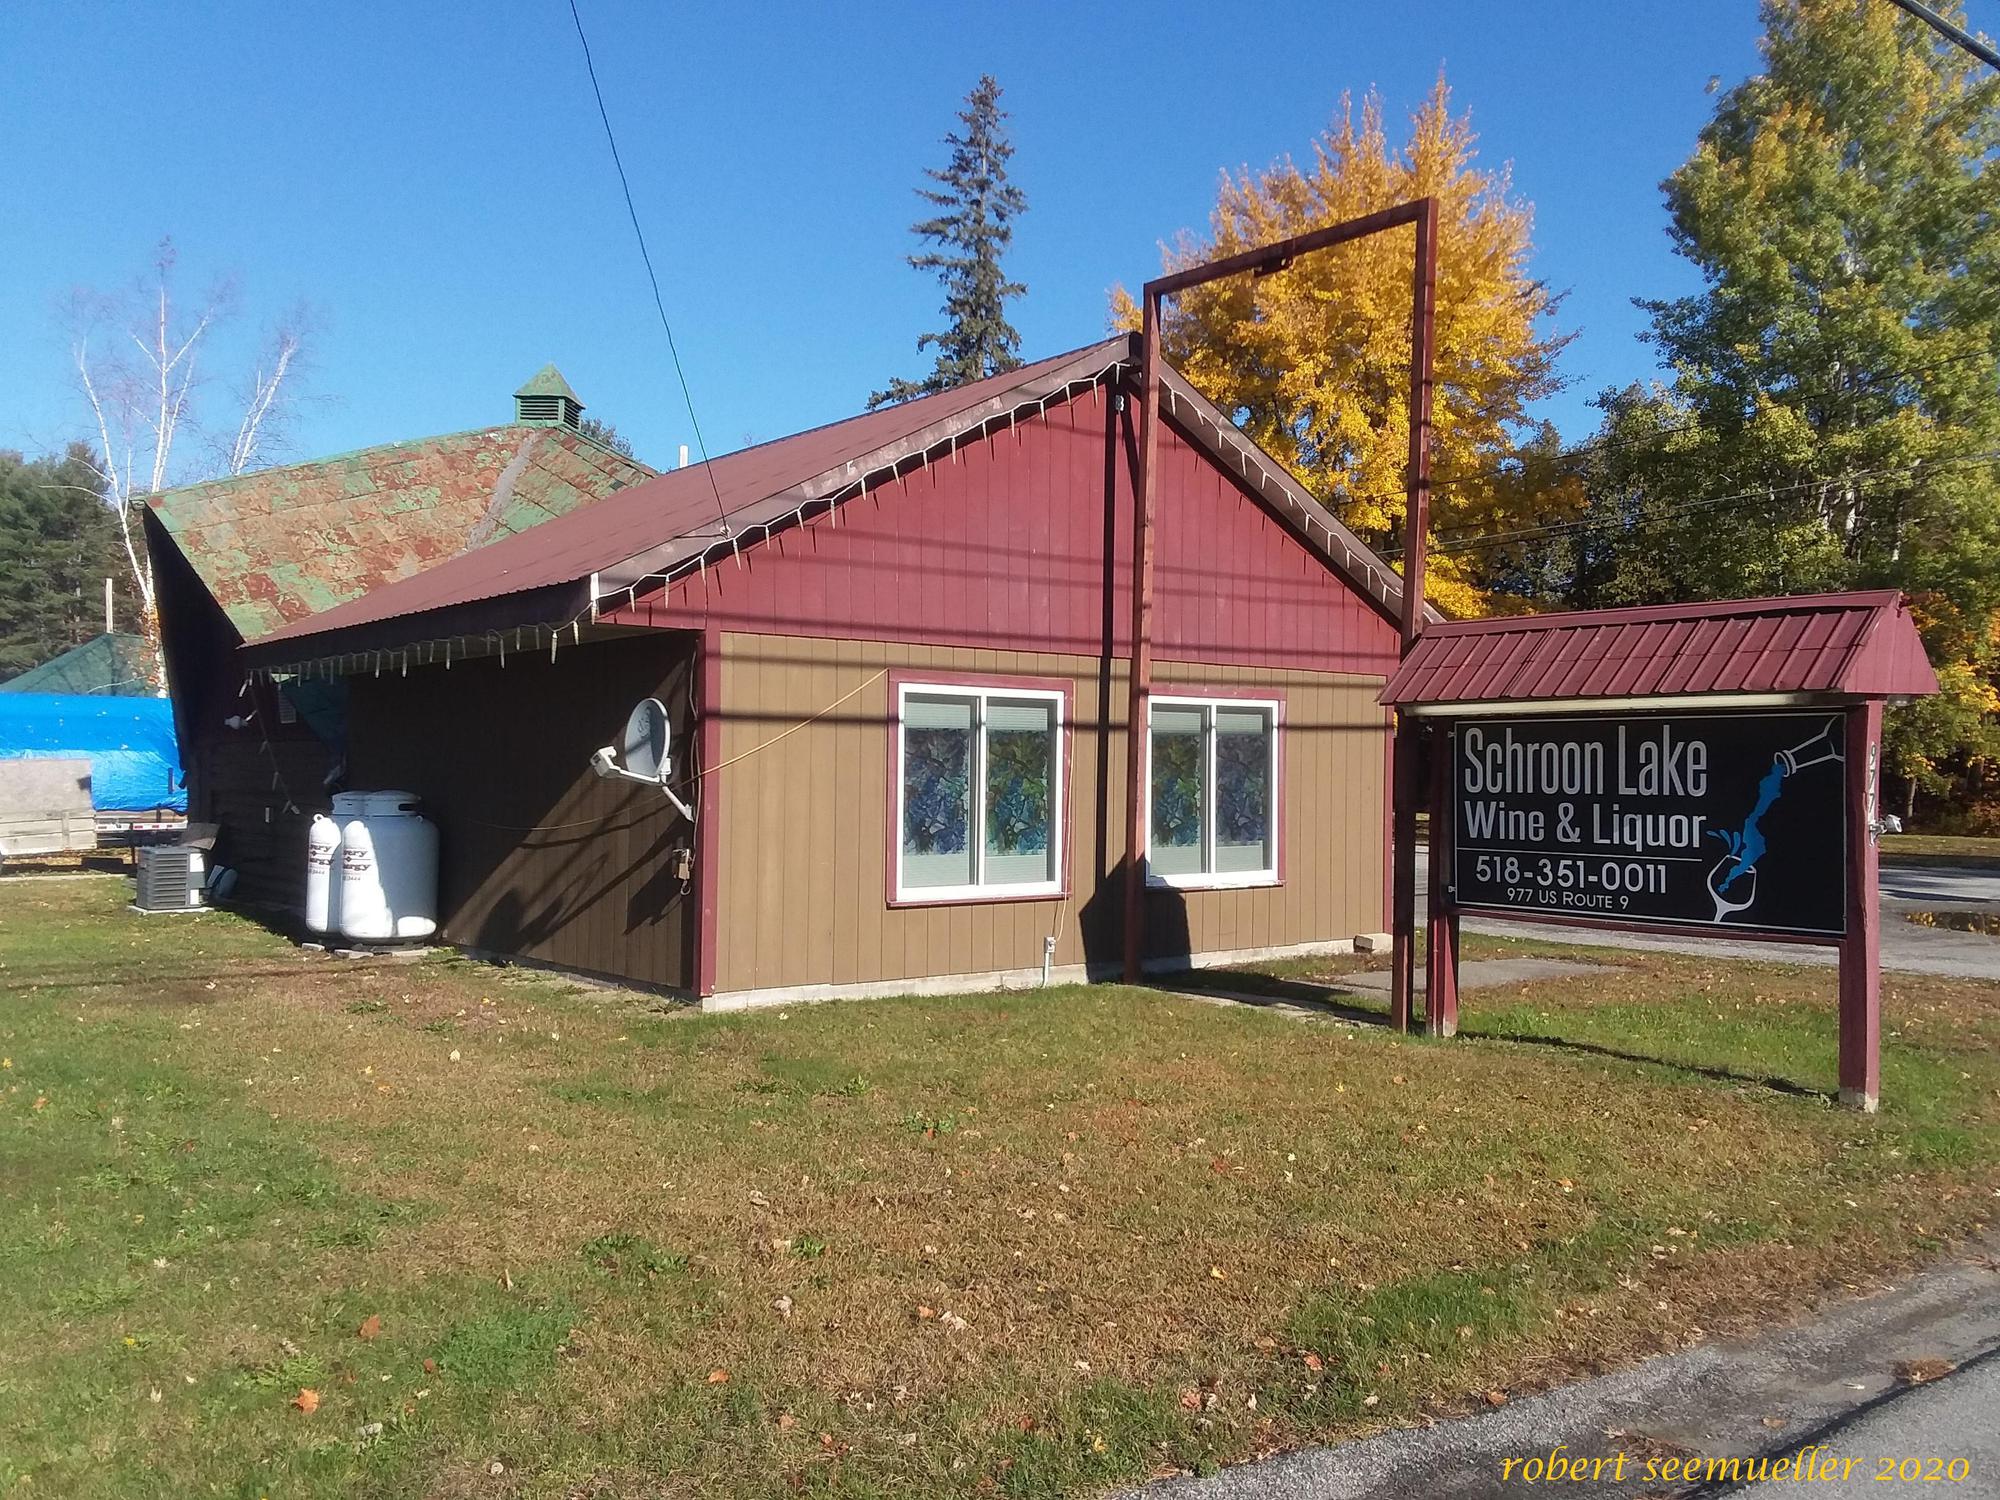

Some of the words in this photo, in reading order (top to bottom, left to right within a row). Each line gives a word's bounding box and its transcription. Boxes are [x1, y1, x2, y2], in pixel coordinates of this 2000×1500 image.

[1464, 727, 1604, 796] Schroon
[1618, 724, 1708, 797] Lake
[1464, 800, 1545, 842] Wine
[1556, 803, 1581, 843] &
[1593, 804, 1707, 852] Liquor
[1476, 855, 1667, 894] 518-351-0011
[1507, 887, 1533, 903] 977
[1539, 890, 1557, 905] US
[1563, 891, 1613, 909] ROUTE
[1619, 895, 1629, 910] 9
